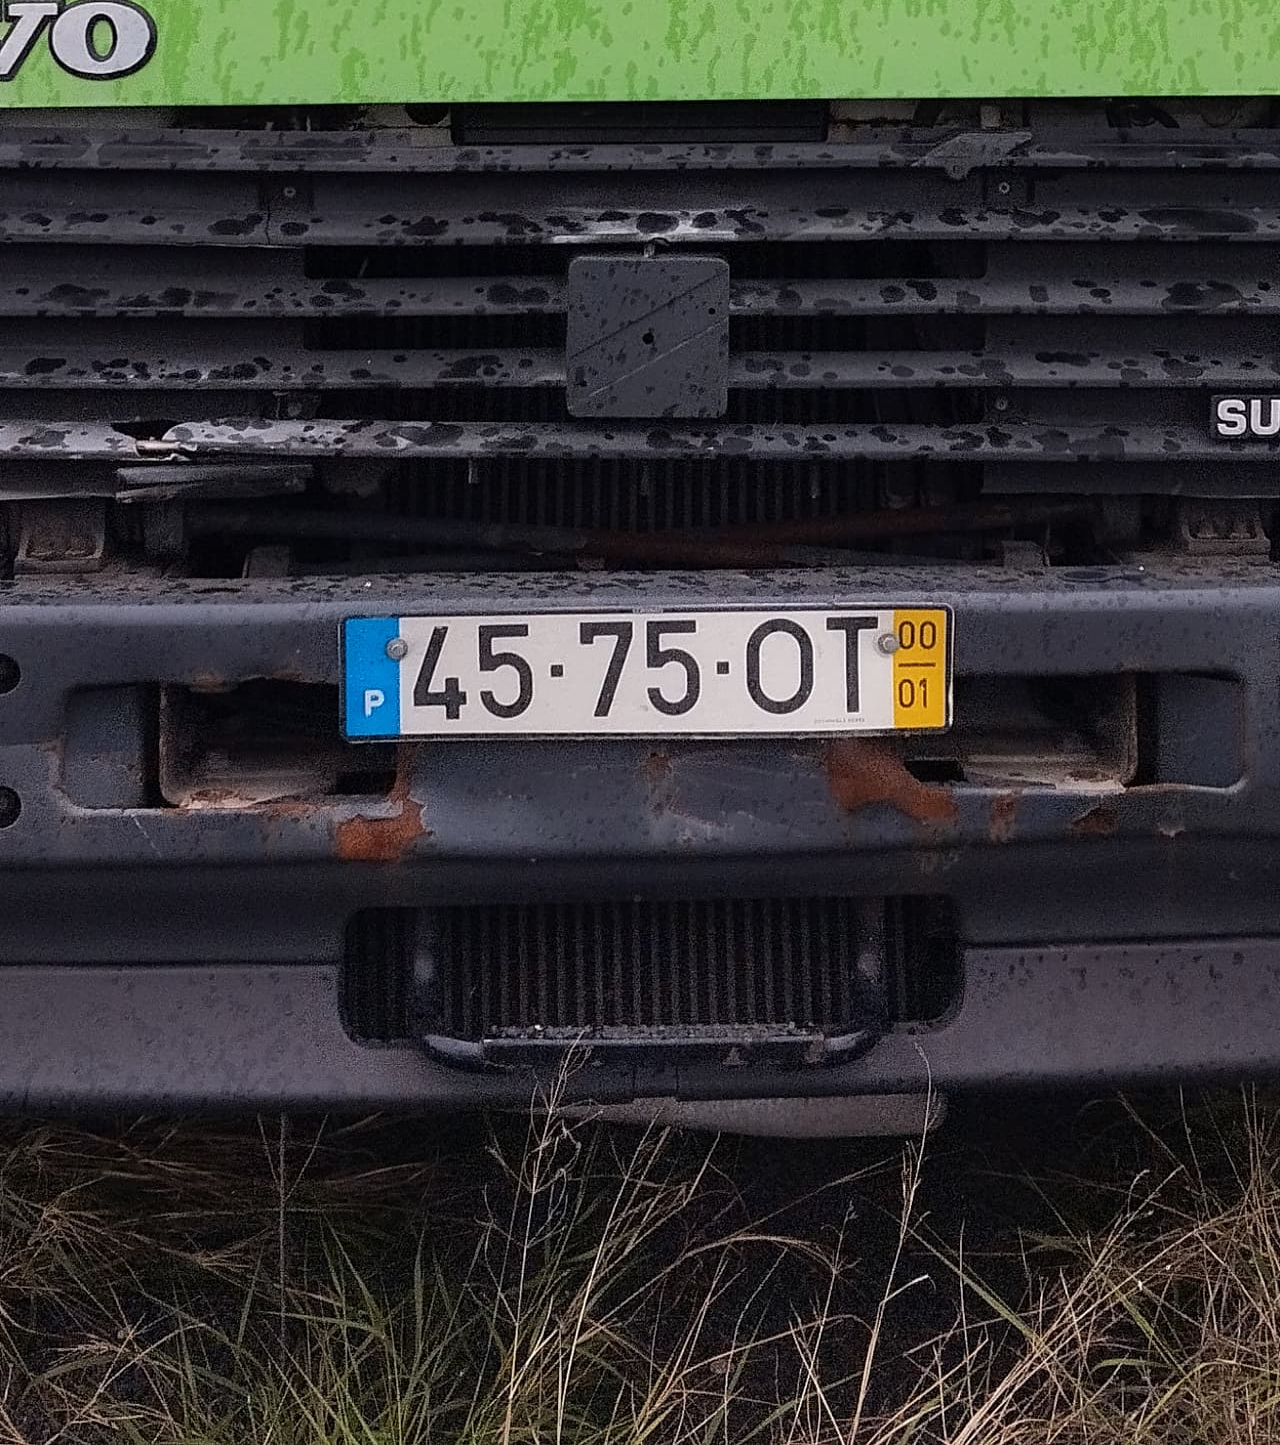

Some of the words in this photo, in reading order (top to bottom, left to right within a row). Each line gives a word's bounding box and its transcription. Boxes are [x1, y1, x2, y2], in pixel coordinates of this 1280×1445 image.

[898, 620, 937, 650] 00
[363, 689, 385, 716] P
[898, 677, 928, 709] 01
